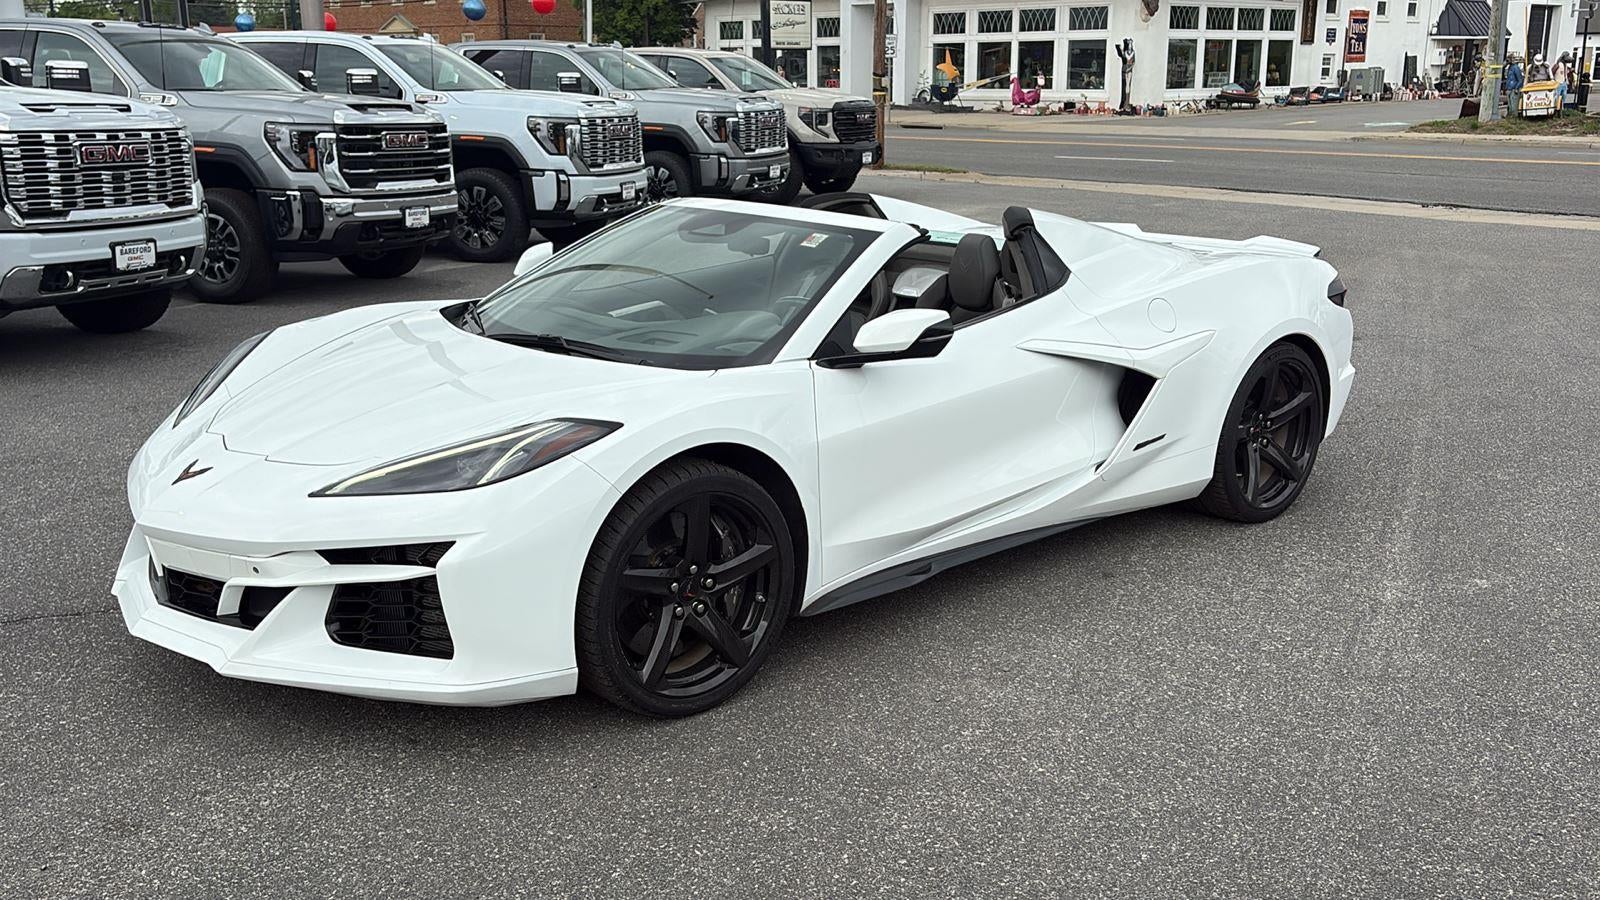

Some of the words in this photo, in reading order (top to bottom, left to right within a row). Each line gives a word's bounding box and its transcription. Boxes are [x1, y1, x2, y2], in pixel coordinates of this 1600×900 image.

[885, 46, 895, 55] 25
[1350, 40, 1363, 52] TEA
[386, 133, 427, 147] GMC
[81, 144, 149, 162] GMC
[120, 246, 152, 255] BAREFORD
